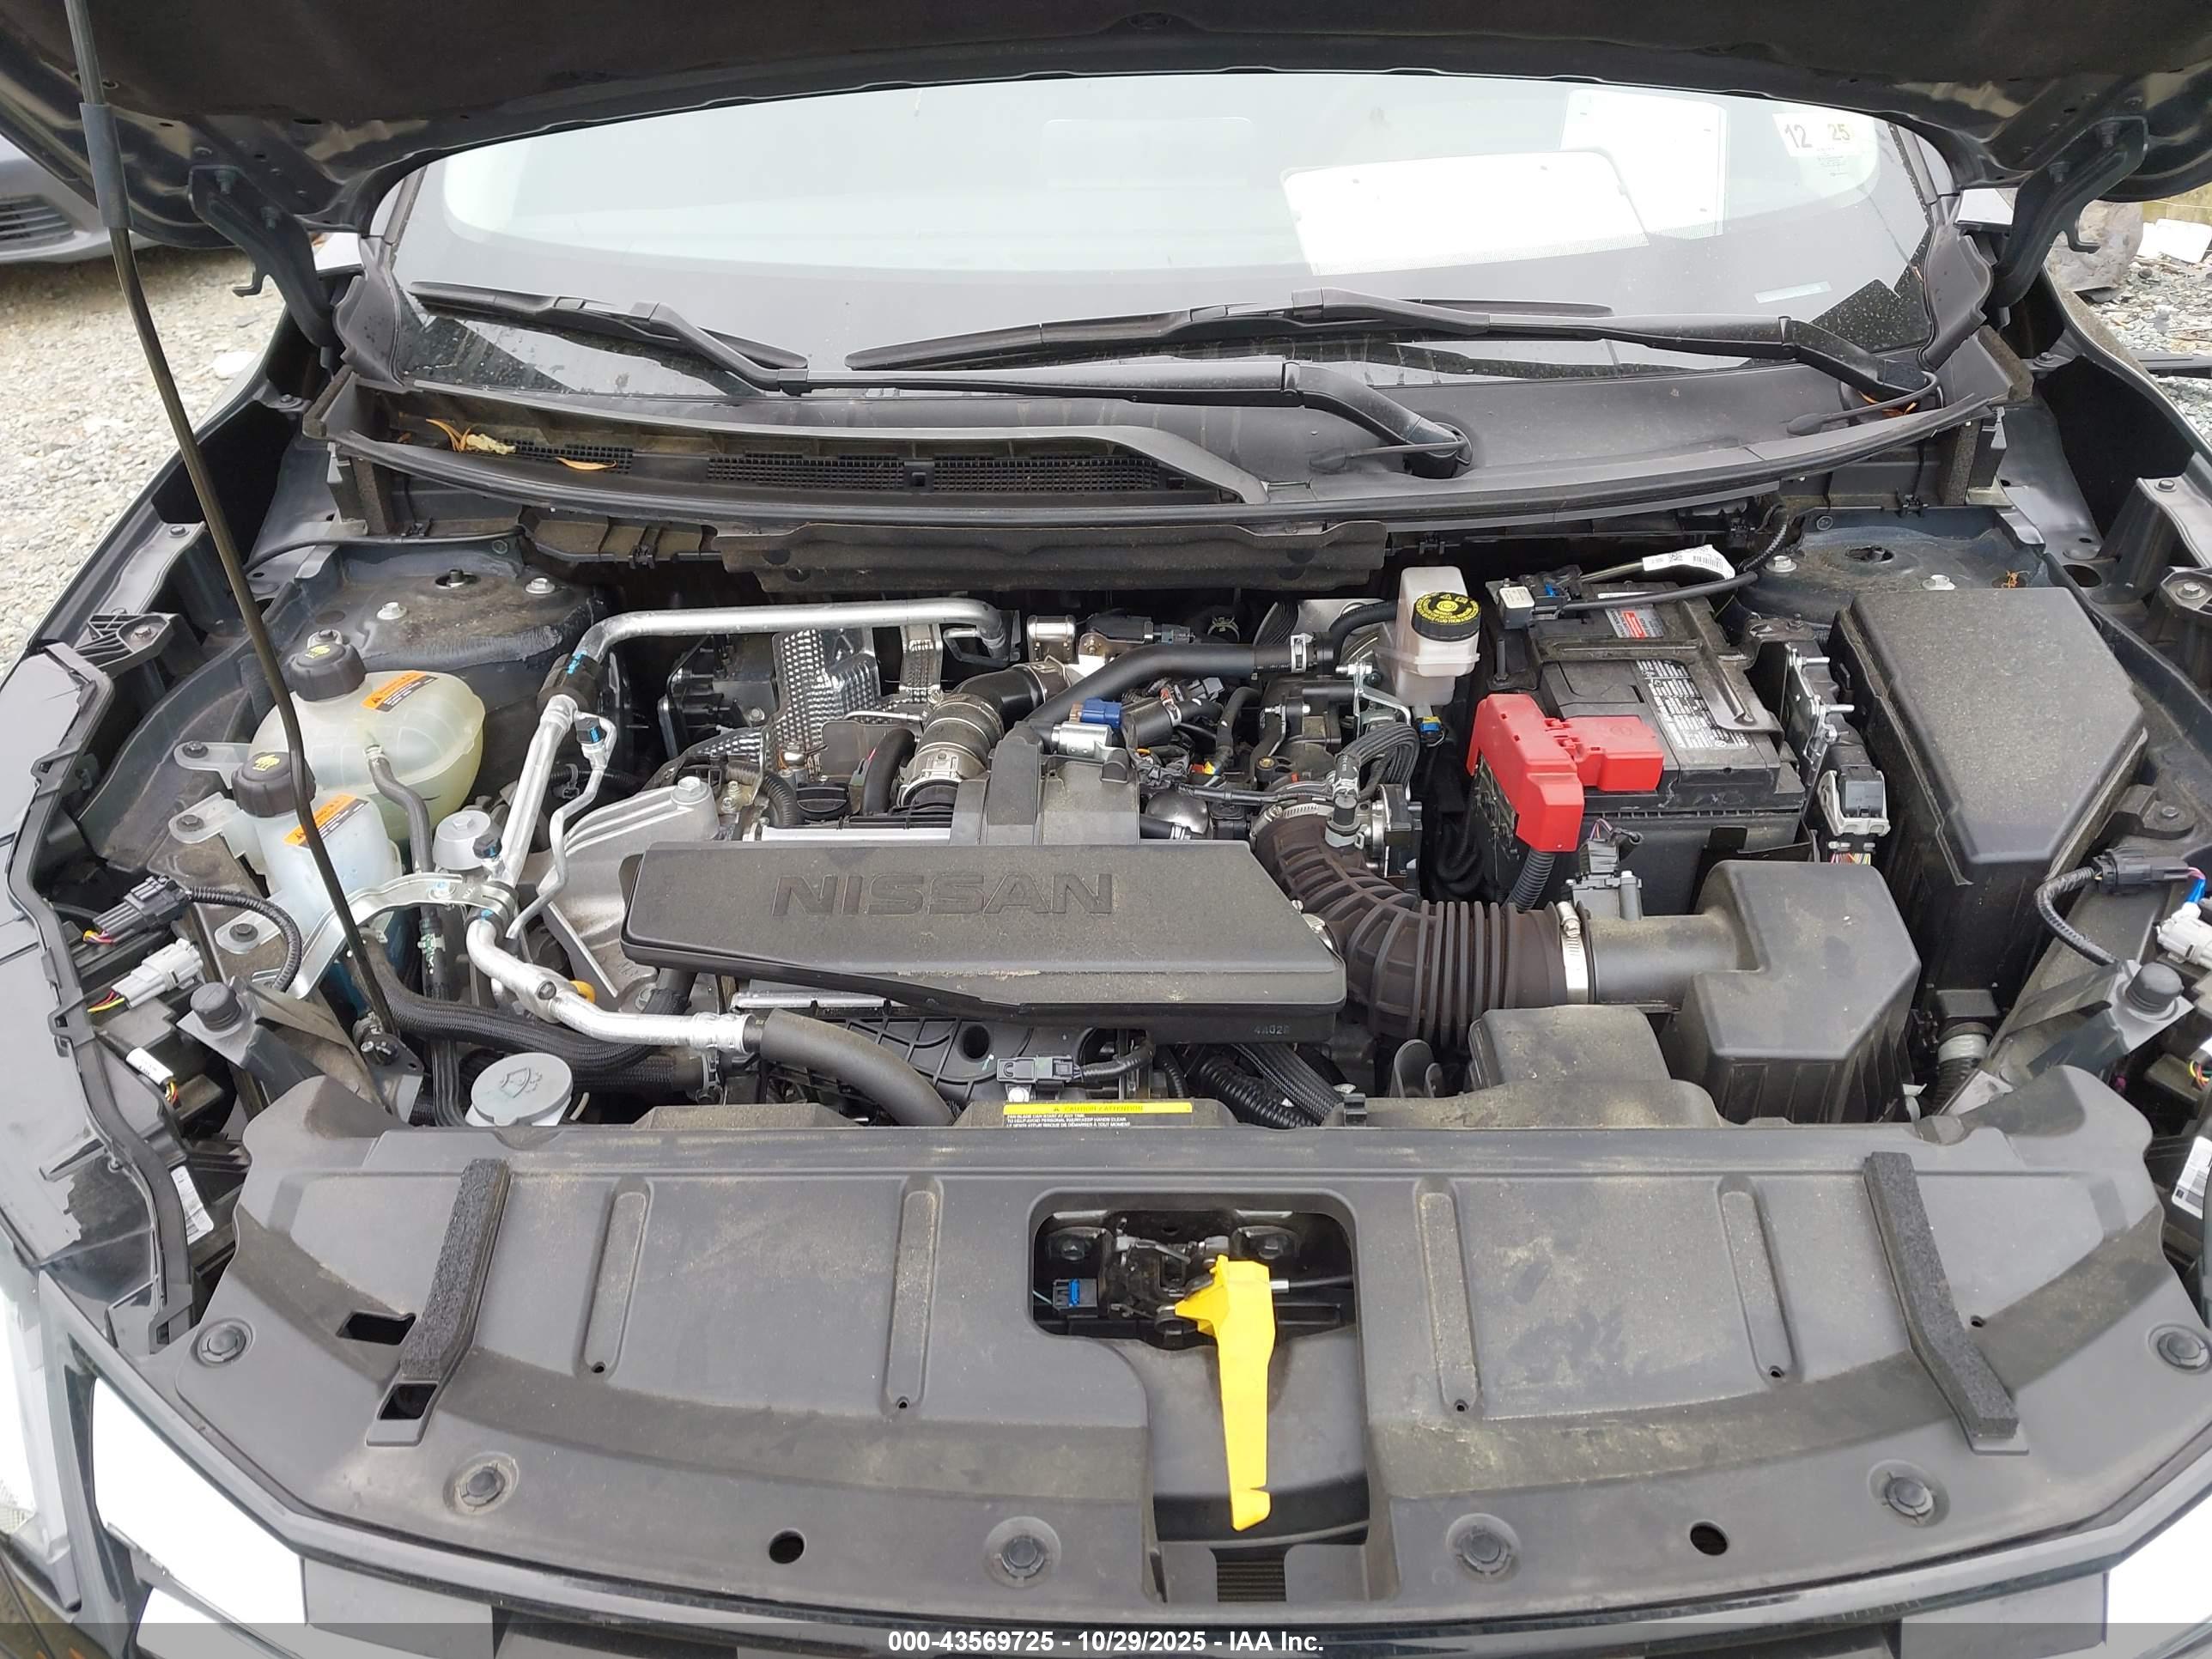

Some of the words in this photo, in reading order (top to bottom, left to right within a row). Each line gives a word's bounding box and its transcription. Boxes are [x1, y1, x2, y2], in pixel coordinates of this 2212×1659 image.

[1785, 124, 1813, 148] 12
[1827, 123, 1850, 140] 25
[773, 872, 1112, 915] NISSAN
